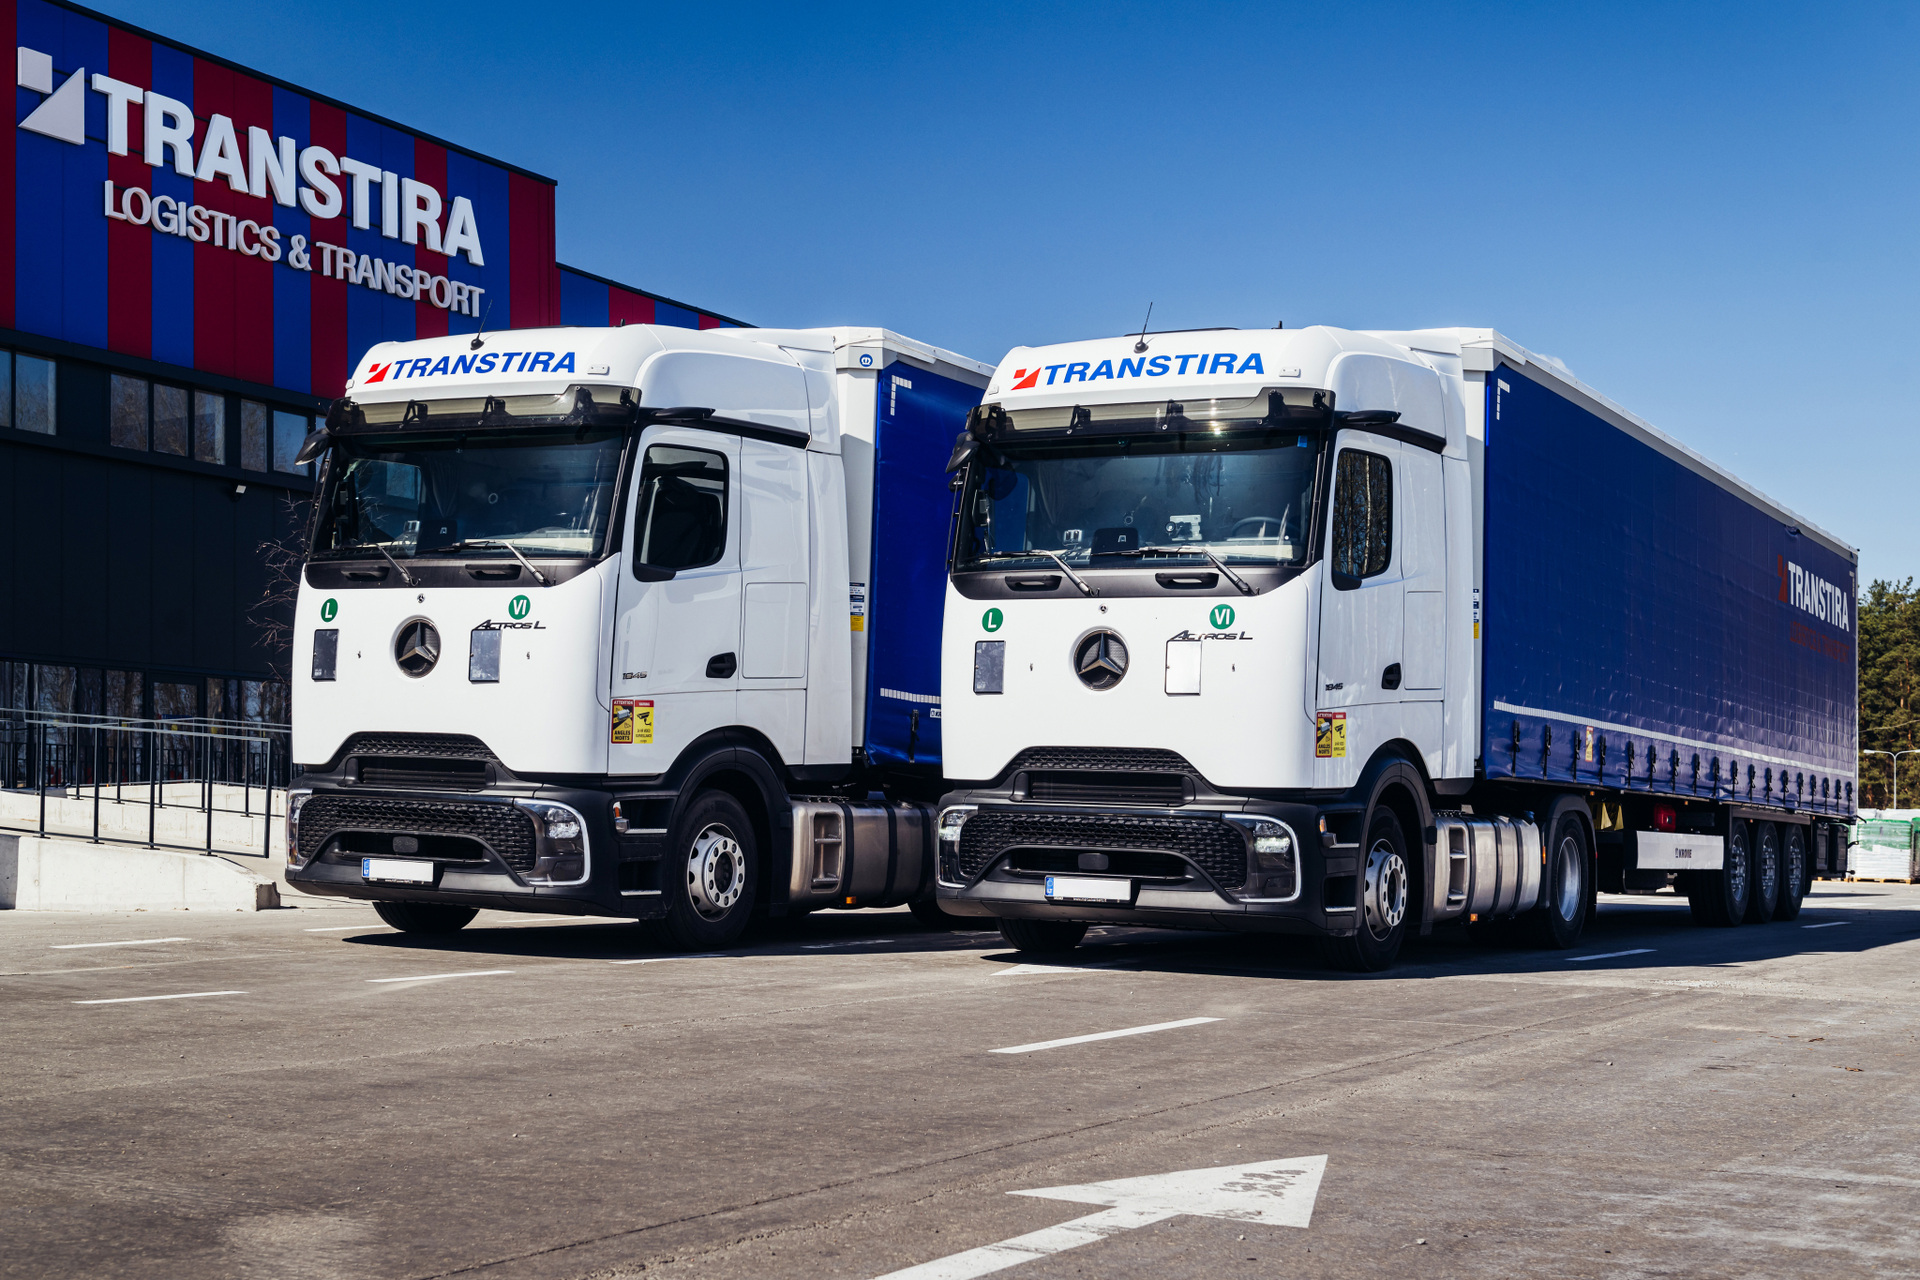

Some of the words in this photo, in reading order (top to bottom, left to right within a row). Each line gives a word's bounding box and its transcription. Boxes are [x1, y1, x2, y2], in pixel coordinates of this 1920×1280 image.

[92, 73, 484, 266] TRANSTIRA
[105, 180, 282, 262] LOGISTICS
[288, 234, 312, 271] &
[316, 241, 485, 317] TRANSPORT
[393, 352, 575, 380] TRANSTIRA
[1045, 353, 1264, 385] TRANSTIRA
[325, 602, 333, 618] L
[513, 599, 527, 615] VI
[1788, 561, 1849, 632] TRANSTIRA
[987, 612, 997, 628] L
[1214, 608, 1230, 625] VI
